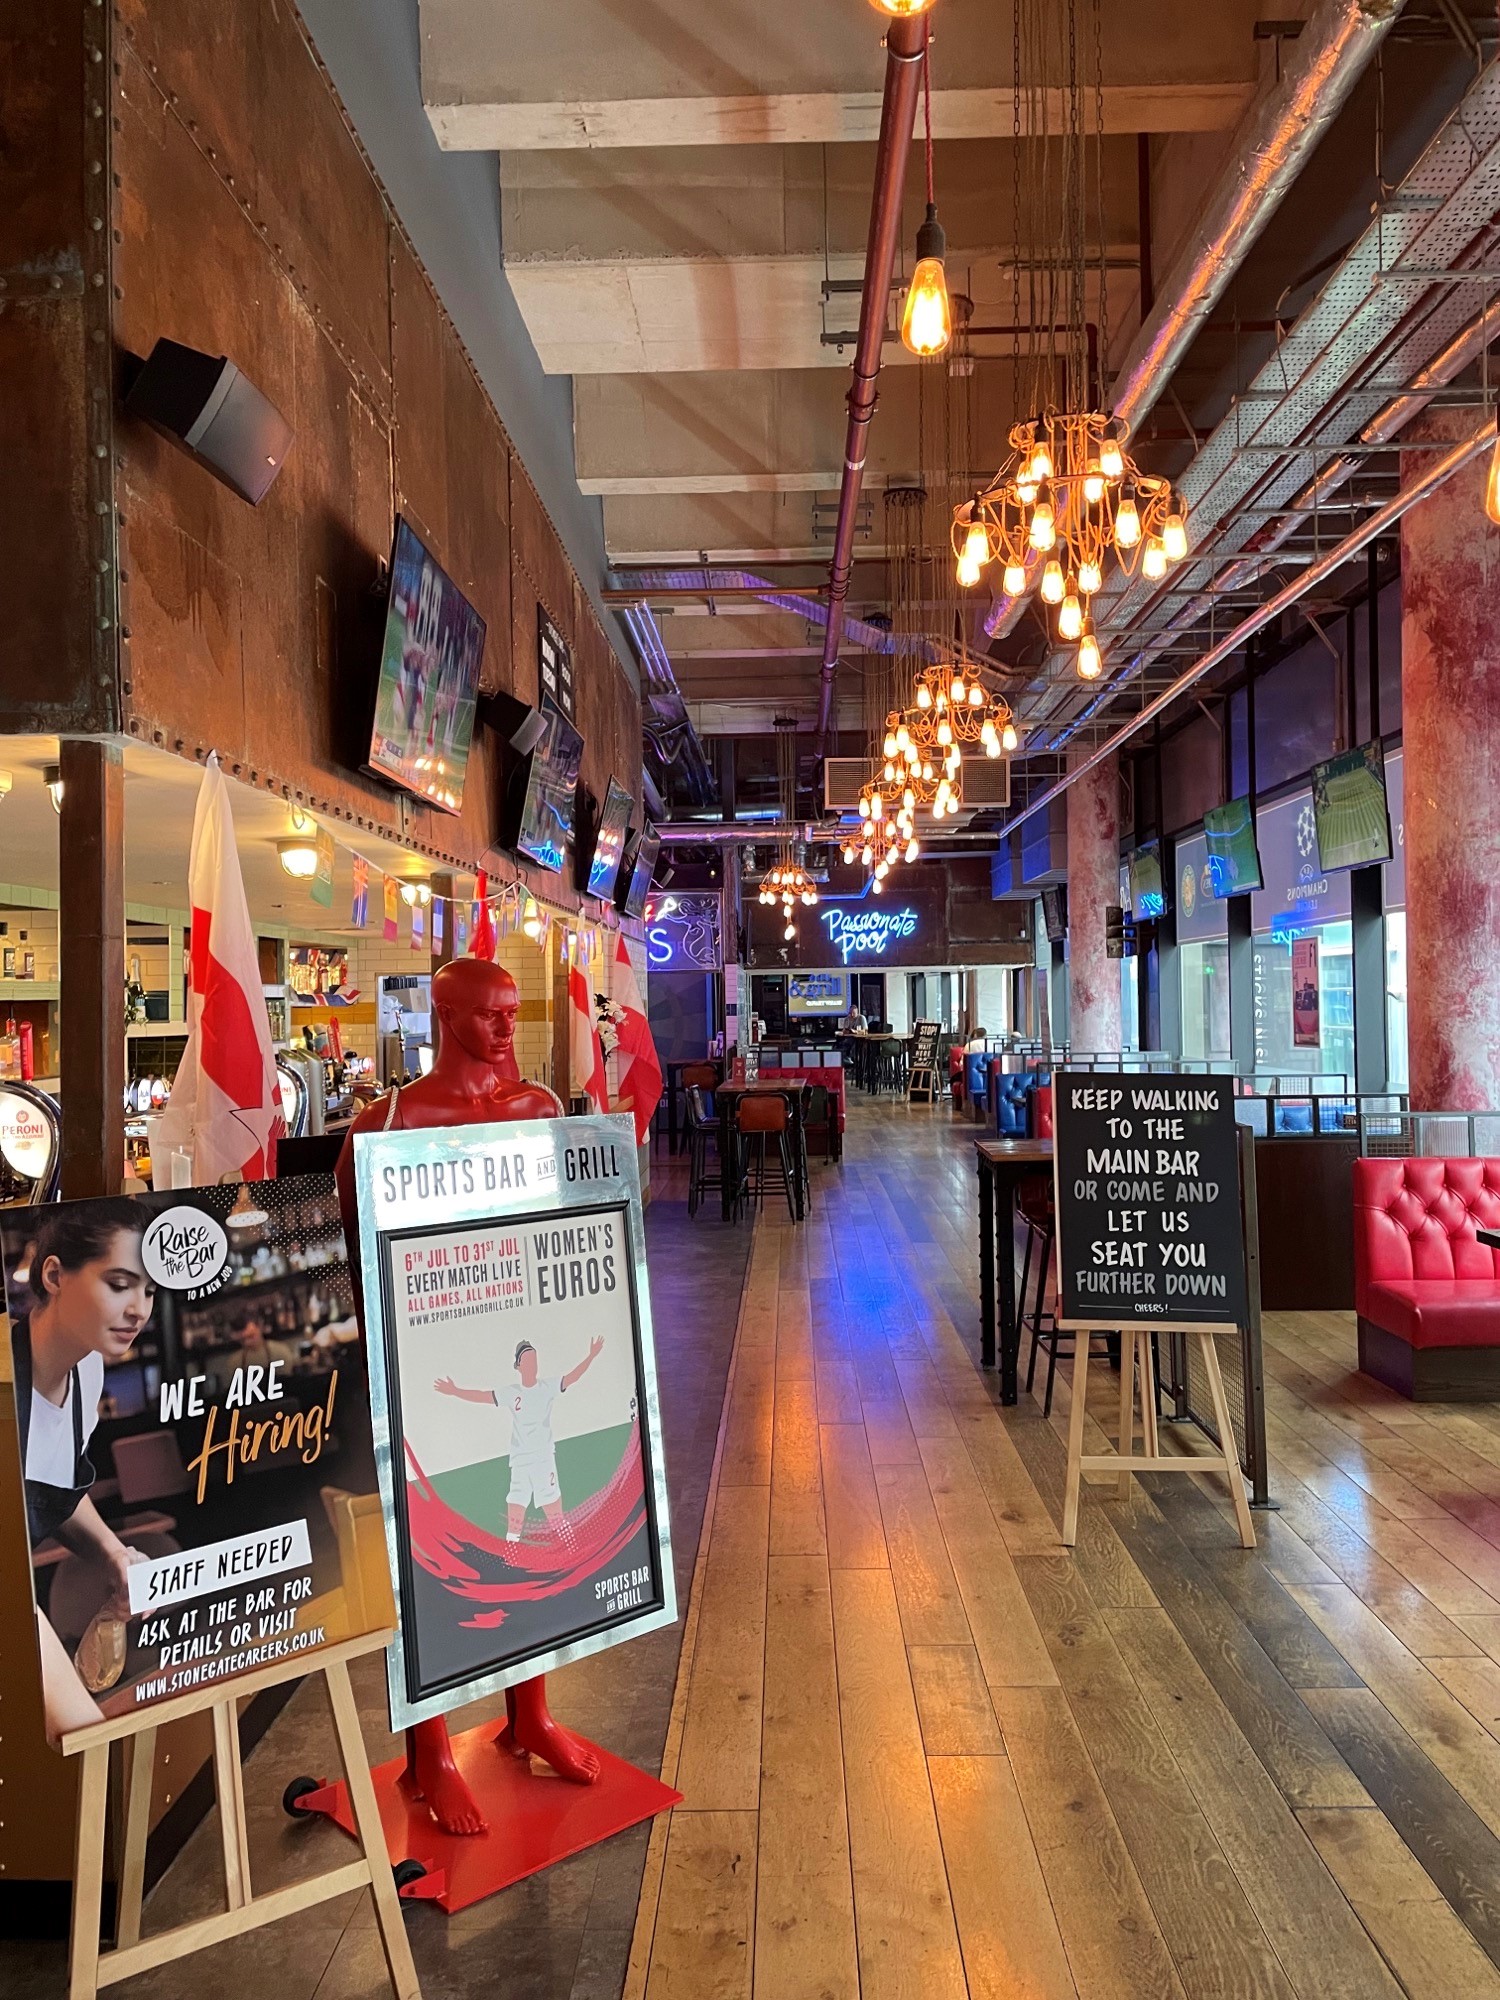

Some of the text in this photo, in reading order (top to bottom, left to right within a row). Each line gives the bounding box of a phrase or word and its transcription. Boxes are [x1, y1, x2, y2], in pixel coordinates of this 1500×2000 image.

[821, 907, 918, 940] Passionate
[920, 1025, 938, 1036] STOP!
[1071, 1088, 1219, 1111] KEEP WALKING
[2, 1124, 43, 1135] PERONI
[1106, 1117, 1185, 1140] TO THE
[382, 1144, 620, 1202] SPORTS BAR AND GRILL
[1086, 1148, 1201, 1177] MAIN BAR
[1074, 1180, 1220, 1203] OR COME AND
[1107, 1210, 1190, 1232] LET US
[149, 1222, 210, 1260] Raise
[404, 1237, 520, 1272] 6TH JUL TO 31ST JUL
[533, 1223, 614, 1260] WOMEN'S
[1090, 1241, 1207, 1268] SEAT YOU
[163, 1241, 218, 1278] the Bar
[187, 1265, 233, 1301] TO A NEW JOB
[407, 1259, 522, 1295] EVERY MATCH LIVE
[537, 1255, 616, 1304] EUROS
[1075, 1270, 1227, 1297] FURTHER DOWN
[408, 1297, 425, 1313] ALL
[466, 1286, 482, 1302] ALL
[485, 1280, 524, 1299] NATIONS
[409, 1296, 525, 1327] WWW.SPORTSBARANDGRILL.CO.UK
[1134, 1303, 1169, 1314] CHEERS!
[160, 1359, 285, 1423] WE ARE
[515, 1396, 522, 1411] 2
[187, 1369, 338, 1505] Hiring!
[550, 1472, 555, 1486] 2
[149, 1535, 293, 1600] STAFF NEEDED
[594, 1565, 650, 1600] SPORTS BAR
[138, 1576, 312, 1648] ASK AT THE BAR FOR
[617, 1587, 642, 1610] GRILL
[160, 1607, 297, 1670] DETAILS OR VISIT
[135, 1627, 326, 1702] WWW.STONEGATECAREERS.CO.UK
